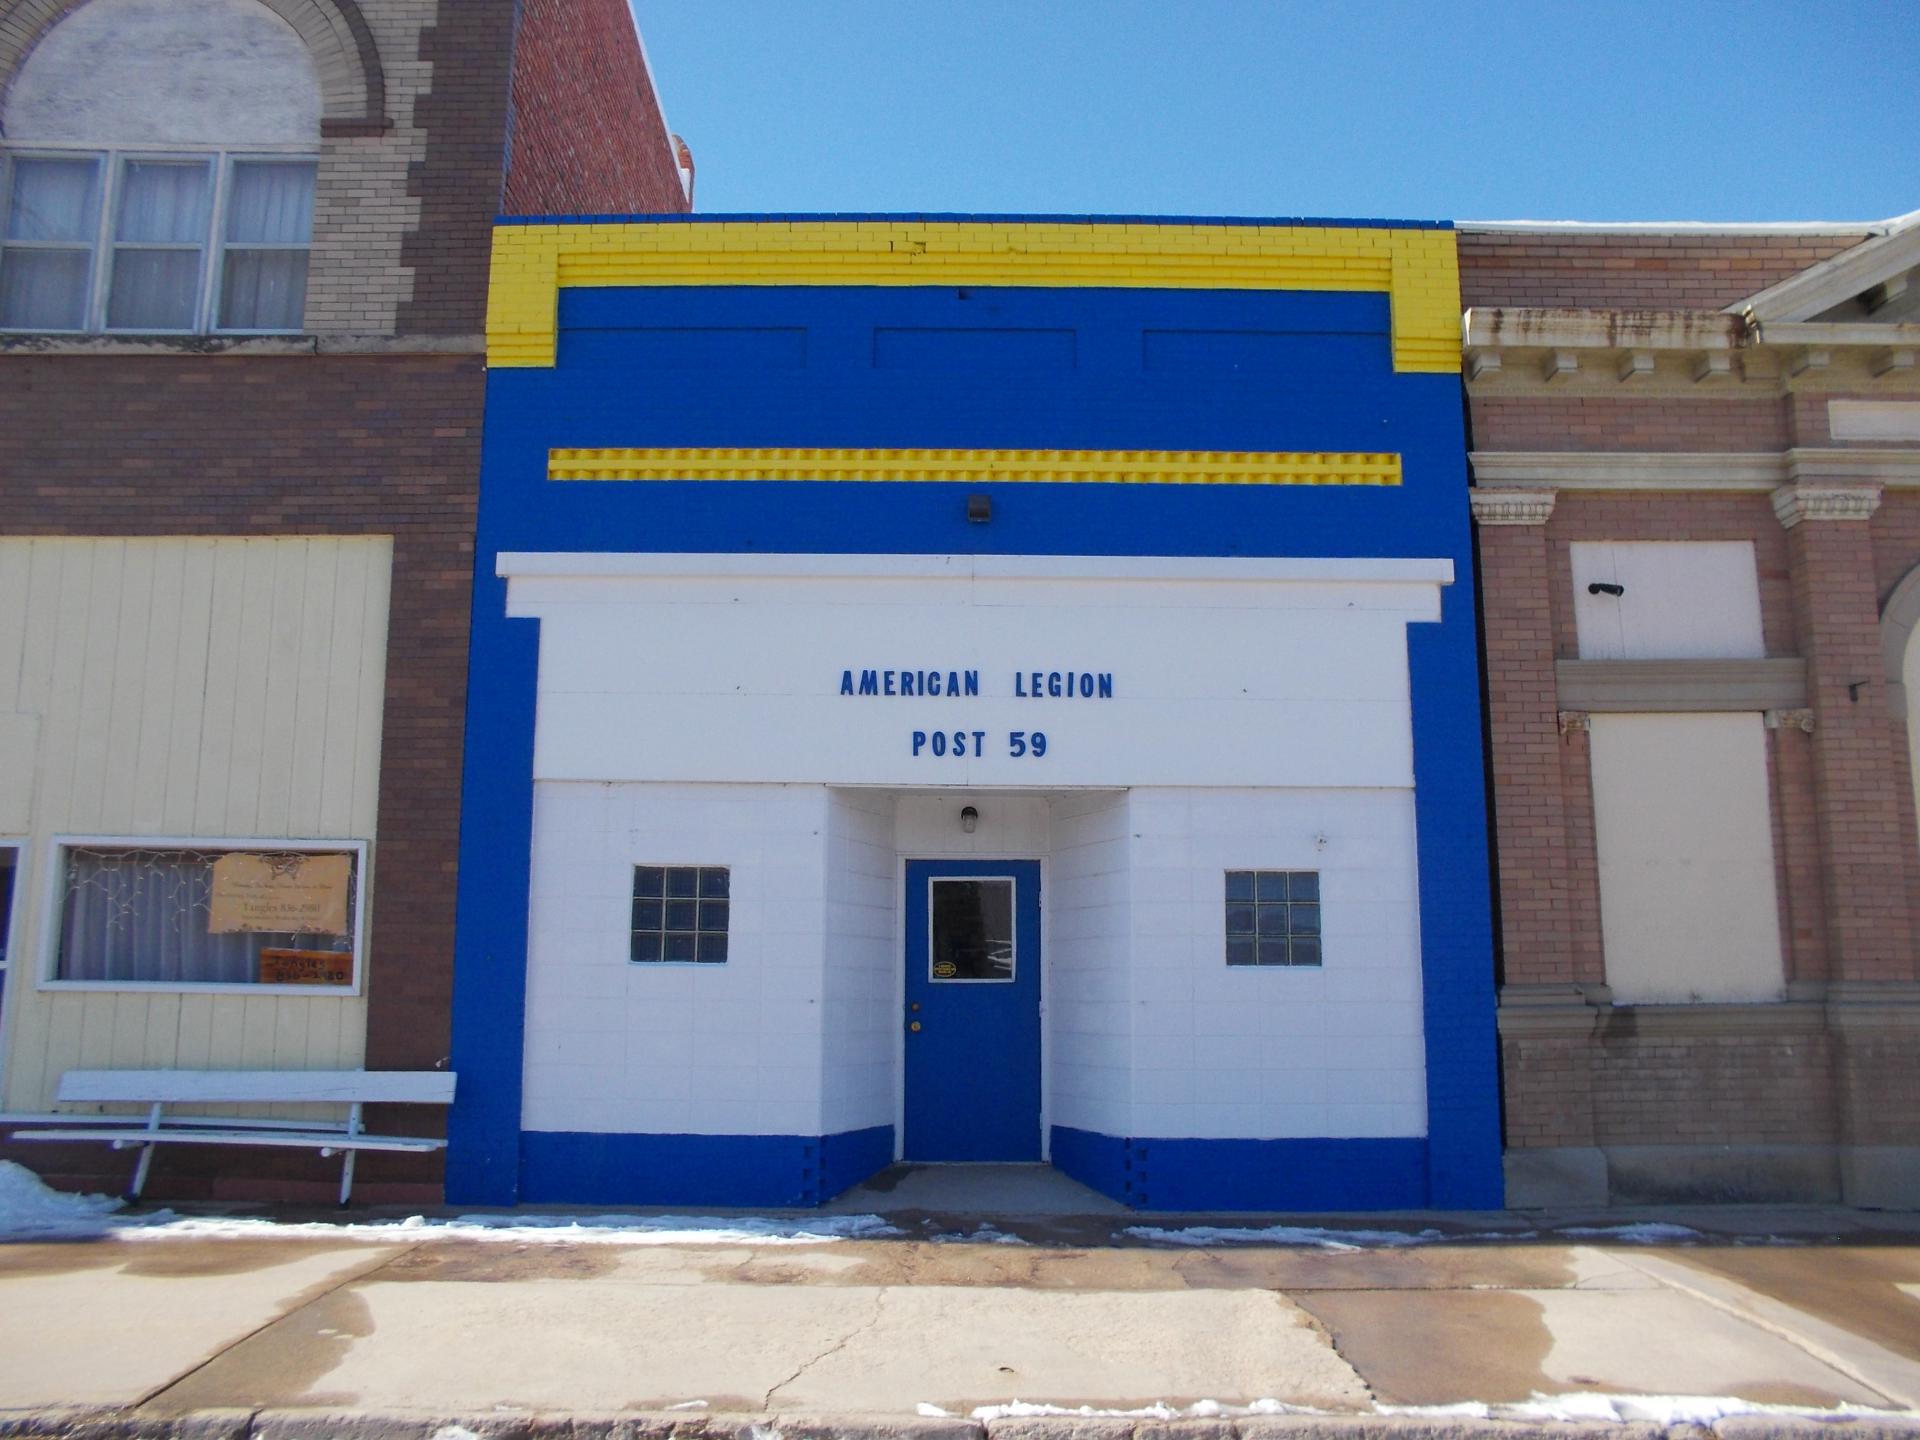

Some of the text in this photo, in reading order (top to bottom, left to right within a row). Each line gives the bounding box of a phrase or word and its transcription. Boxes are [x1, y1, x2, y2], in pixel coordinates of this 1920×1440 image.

[840, 669, 1113, 698] AMERICAN LEGION
[912, 731, 1047, 758] POST 59
